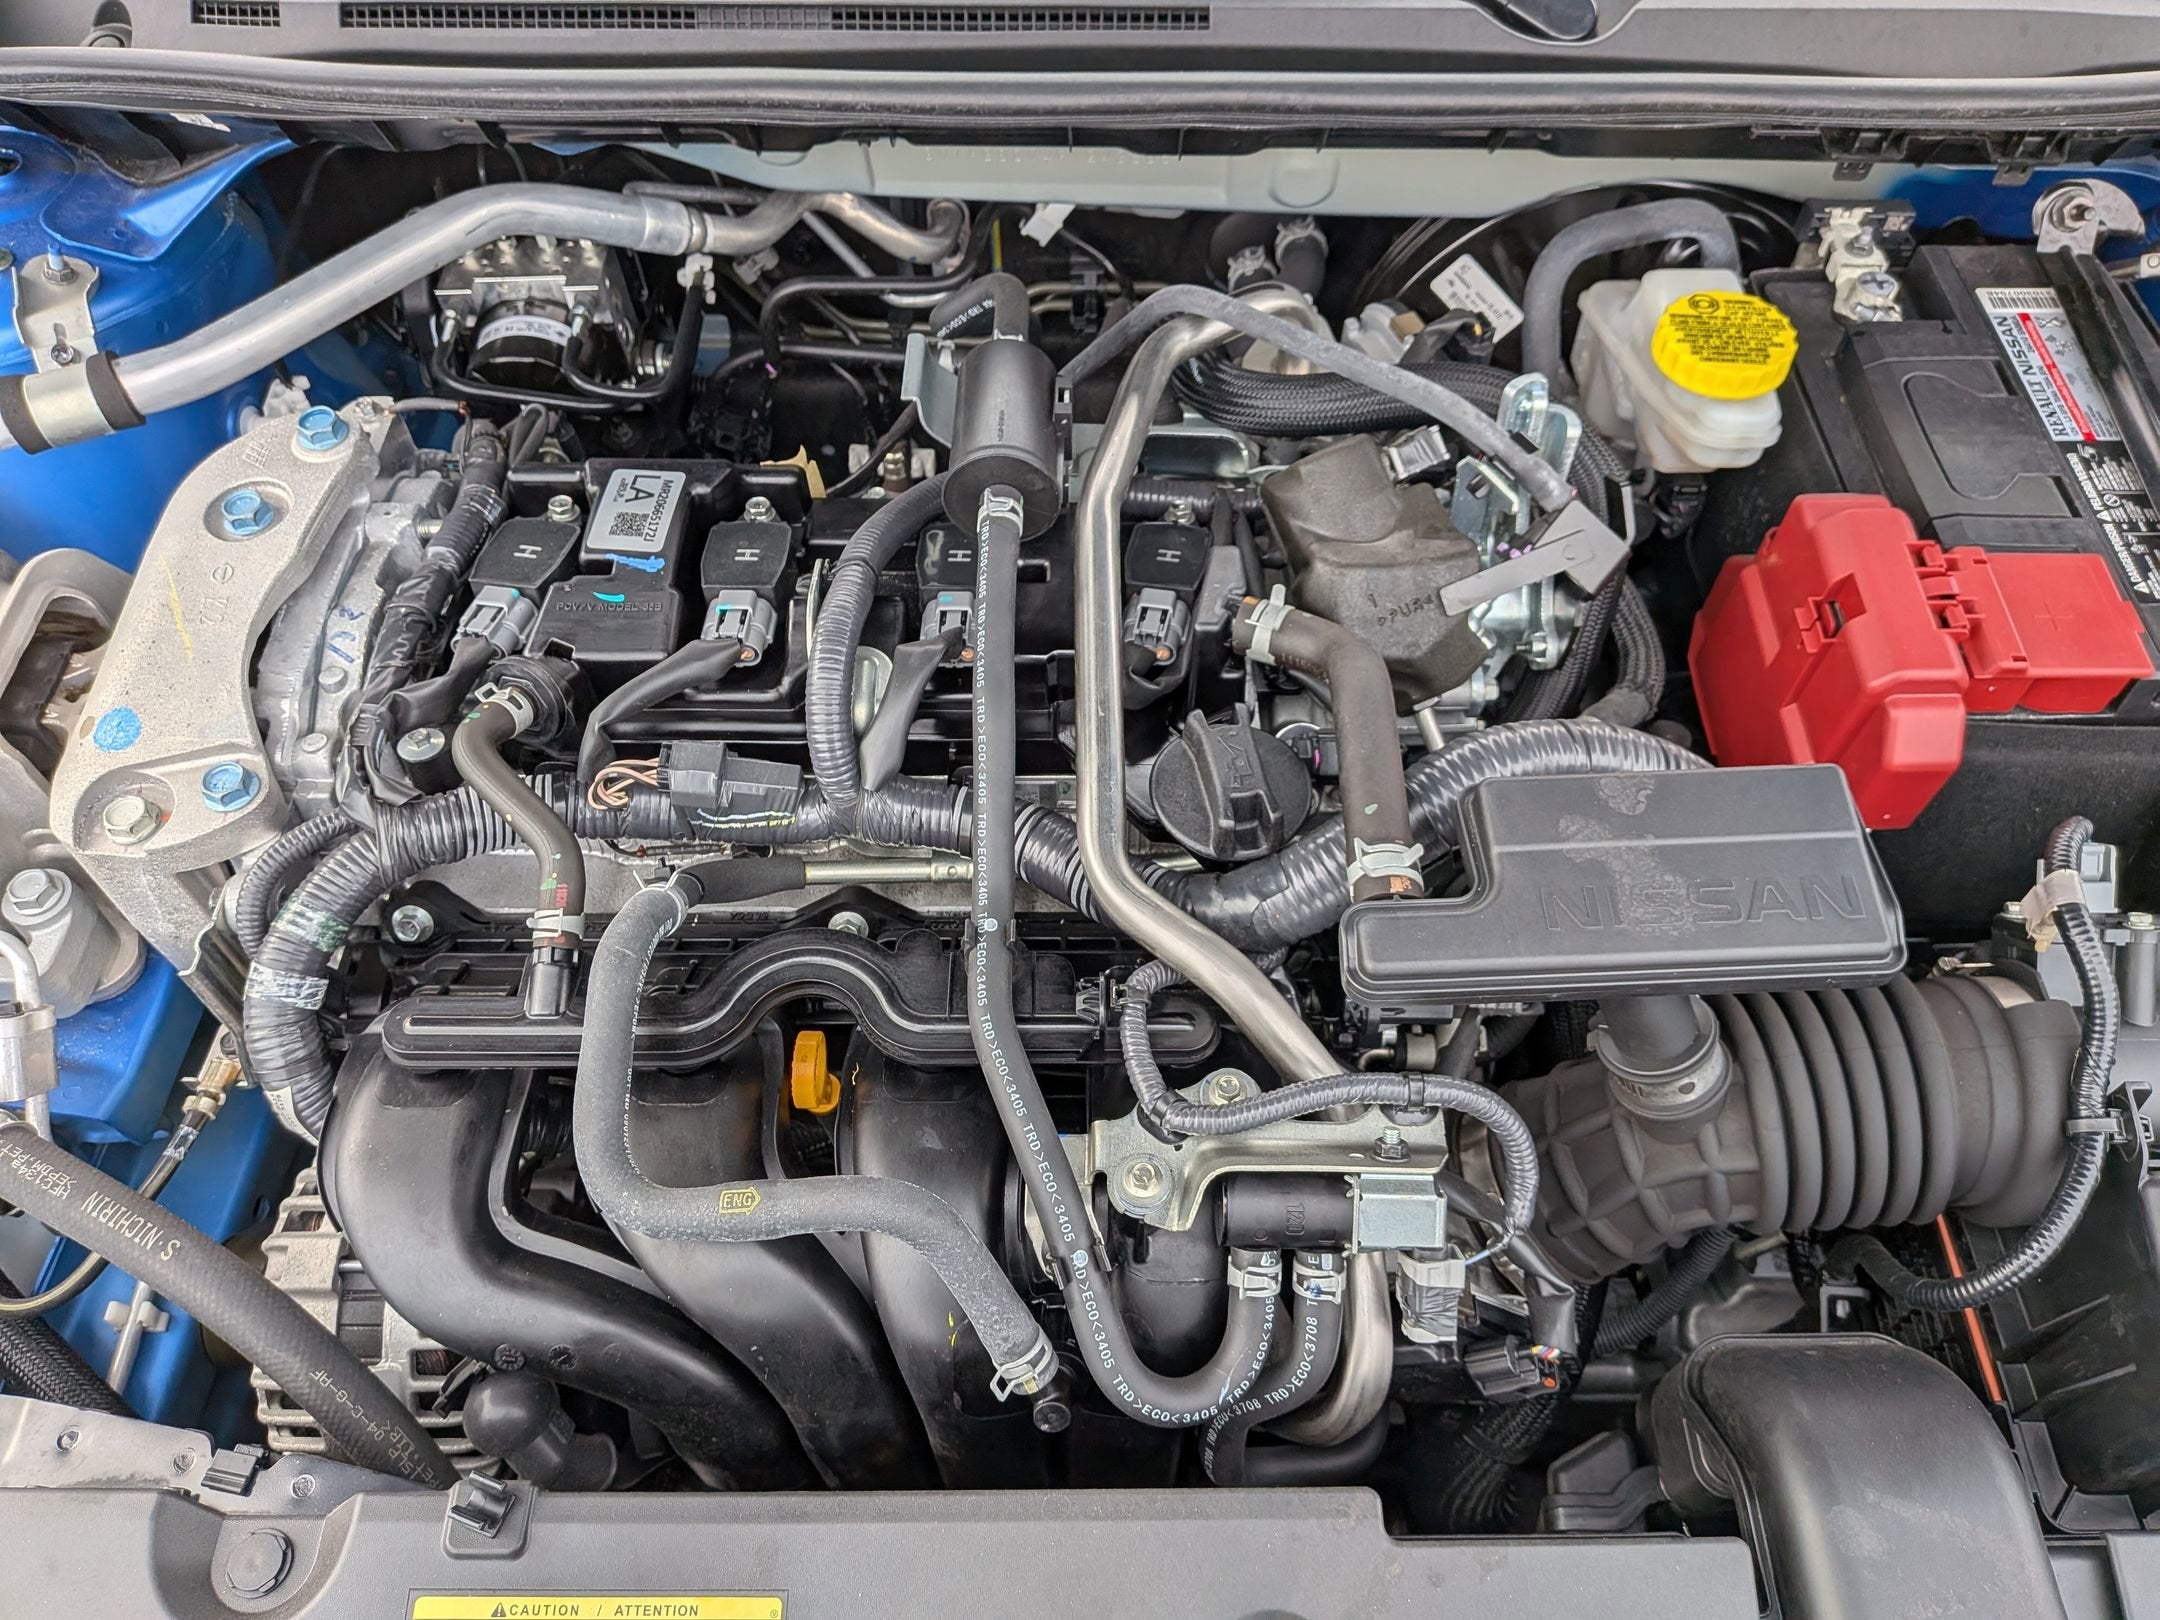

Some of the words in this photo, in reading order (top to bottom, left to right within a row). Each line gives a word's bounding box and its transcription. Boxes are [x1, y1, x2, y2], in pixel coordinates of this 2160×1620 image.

[1993, 316, 2037, 375] NISSAN
[2027, 380, 2069, 437] RENAULT
[625, 475, 662, 503] LA
[978, 520, 990, 599] TRD>ECO<3405
[597, 602, 638, 612] MODEL
[976, 602, 987, 688] TRD>ECO<3405
[976, 696, 987, 804] TRD>ECO<3405
[977, 813, 988, 906] TRD>ECO<3405
[1539, 875, 1866, 931] NISSAN
[980, 1013, 1028, 1117] TRD>ECO<3405
[723, 1191, 753, 1208] ENG
[1023, 1122, 1076, 1242] TRD>ECO<3405
[1226, 1296, 1275, 1404] TRD>ECO<3405
[1264, 1316, 1318, 1406] TRD>ECO<3708
[1112, 1374, 1218, 1423] TRD>ECO<3405
[509, 1603, 580, 1617] CAUTION
[614, 1603, 699, 1617] ATTENTION
